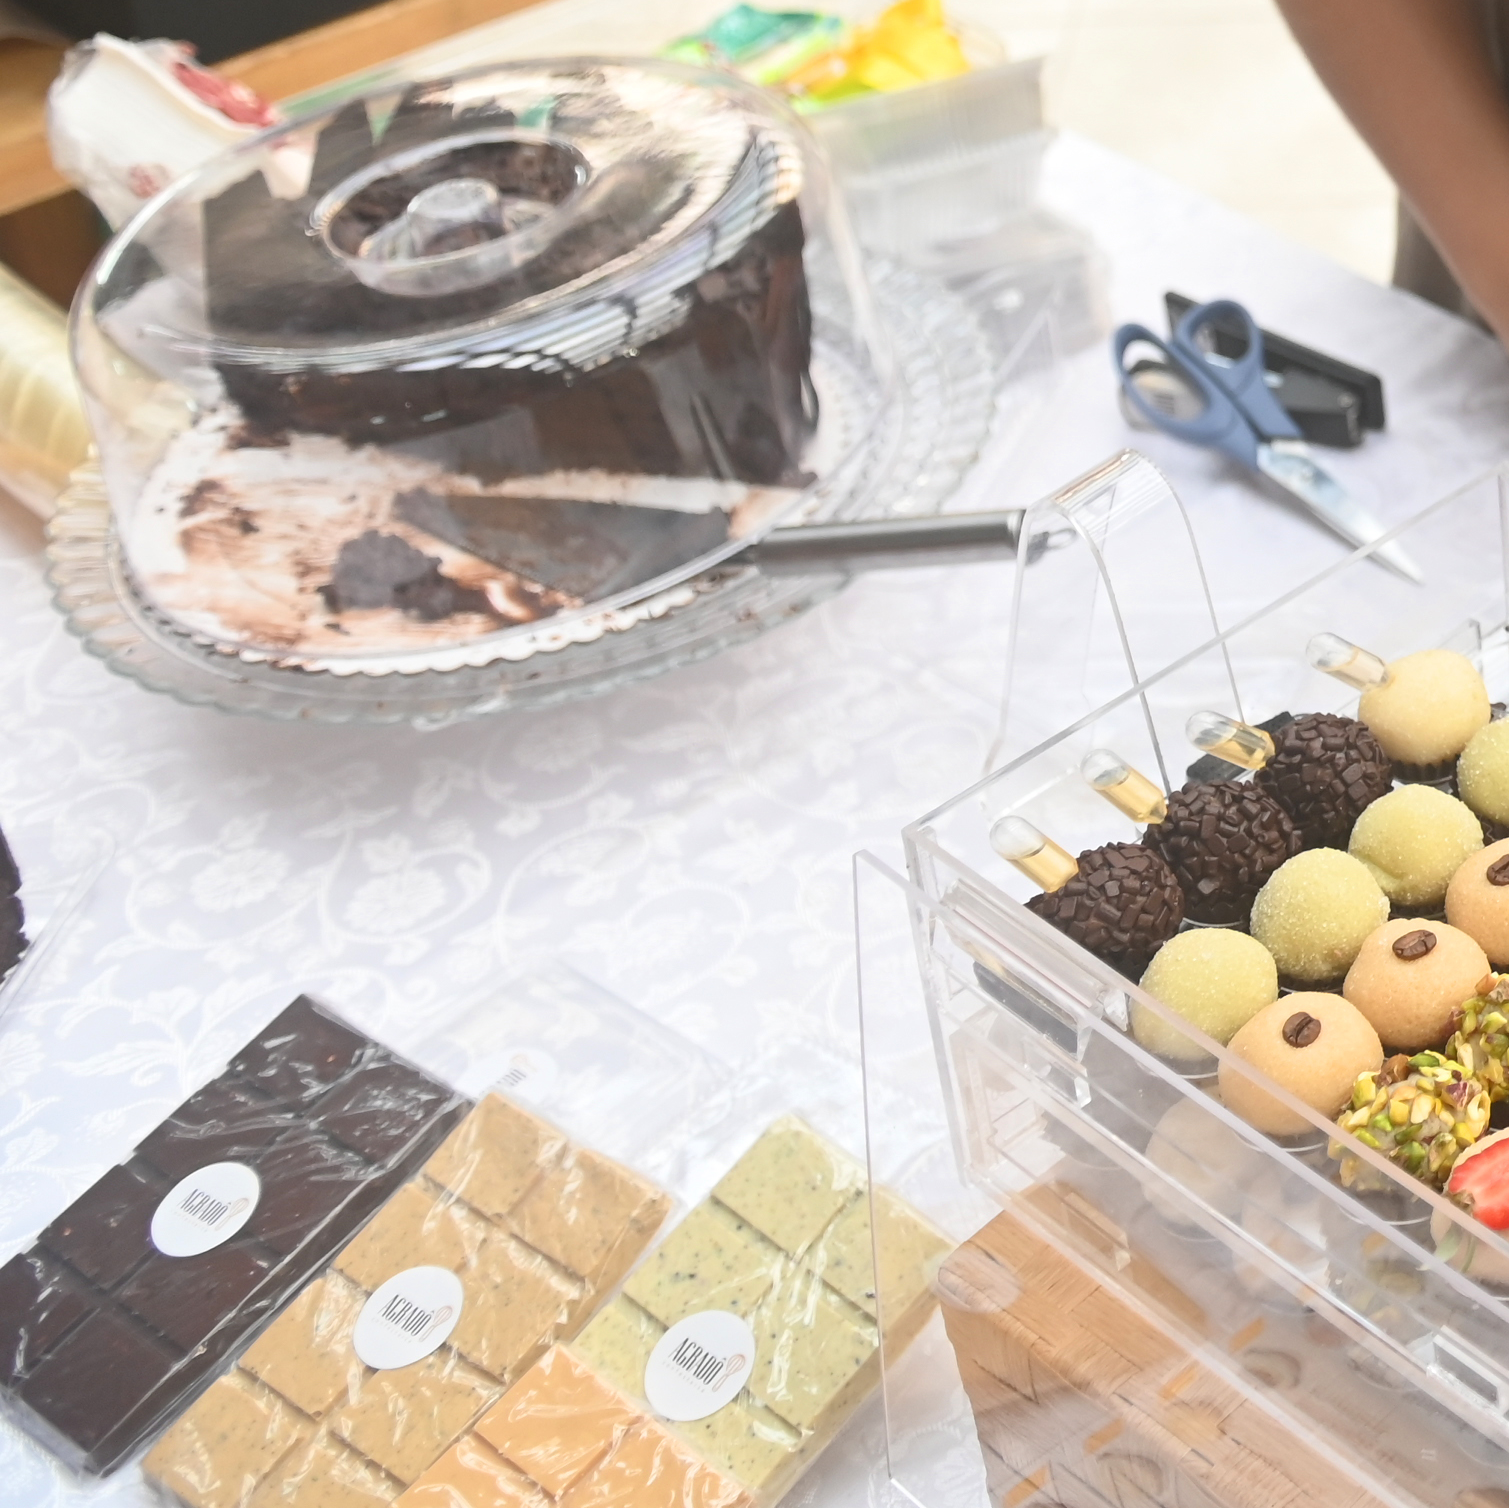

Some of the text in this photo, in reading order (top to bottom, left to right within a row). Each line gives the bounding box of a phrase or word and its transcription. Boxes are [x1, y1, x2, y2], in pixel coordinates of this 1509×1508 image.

[177, 1189, 231, 1226] AGRADÔ
[378, 1294, 435, 1336] AGRADÔ
[668, 1337, 726, 1385] AGRADÔ
